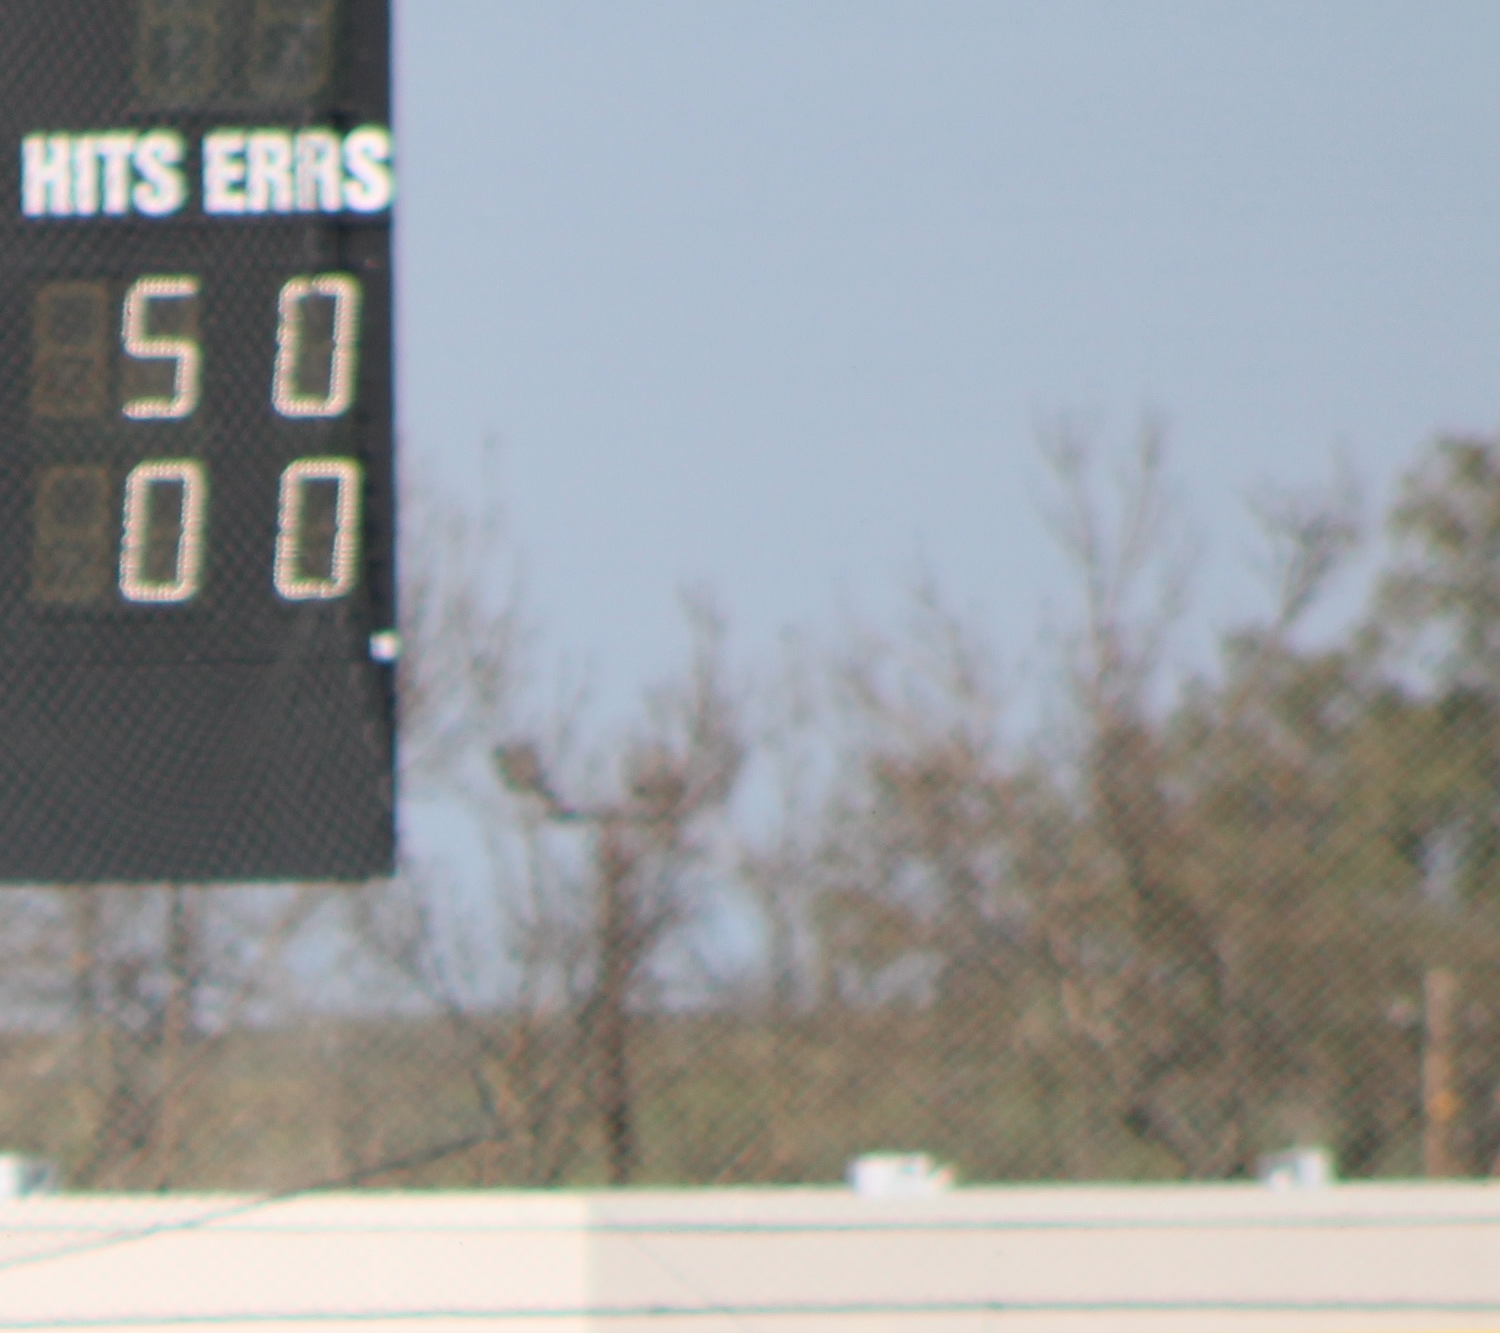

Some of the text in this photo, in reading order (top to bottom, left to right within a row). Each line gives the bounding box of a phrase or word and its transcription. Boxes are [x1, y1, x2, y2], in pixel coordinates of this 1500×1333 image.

[21, 131, 185, 217] HITS
[202, 127, 394, 215] ERRS
[120, 278, 198, 420] 5
[271, 277, 356, 418] 0
[118, 461, 204, 603] 0
[272, 459, 358, 601] 0
